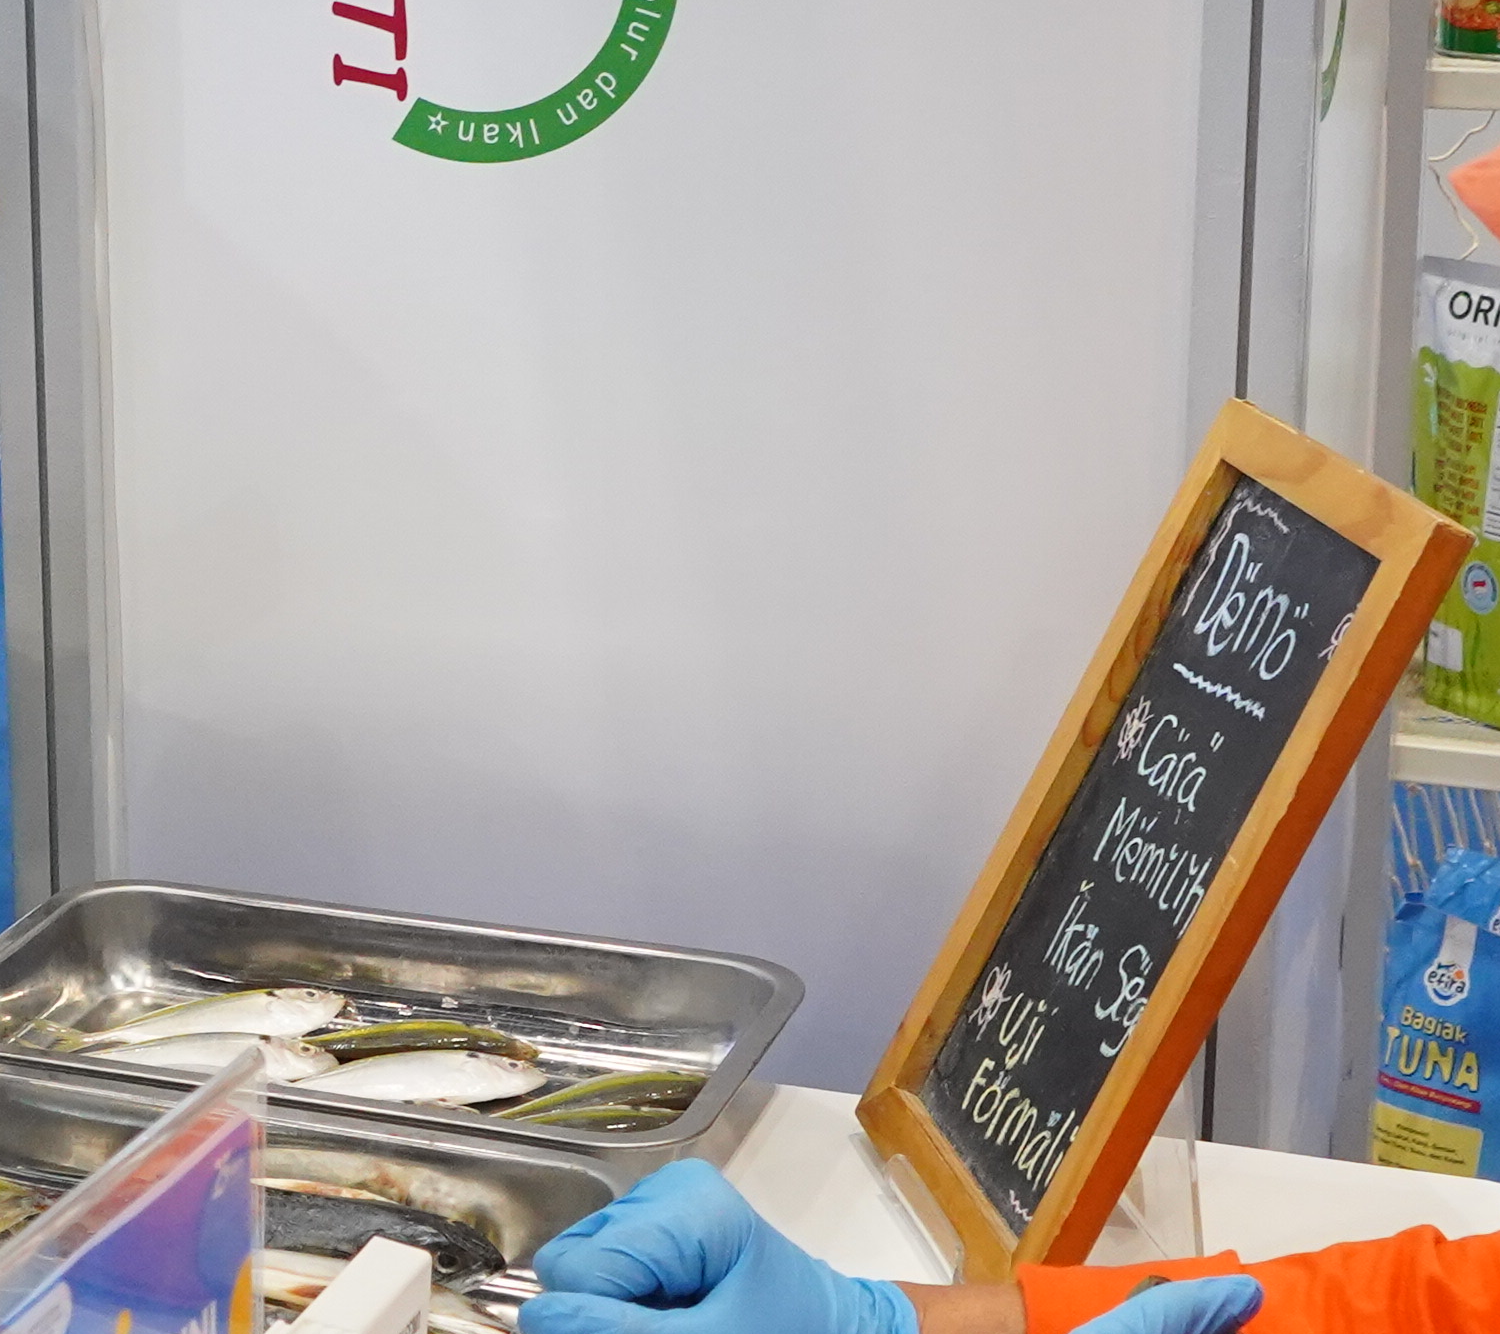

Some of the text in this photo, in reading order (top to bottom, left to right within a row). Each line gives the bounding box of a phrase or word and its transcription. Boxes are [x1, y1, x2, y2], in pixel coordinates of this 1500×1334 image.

[555, 69, 619, 127] dan
[456, 117, 541, 150] Ikan
[1427, 969, 1467, 995] efira
[1400, 1005, 1469, 1045] Bagiak
[1384, 1025, 1481, 1093] TUNA
